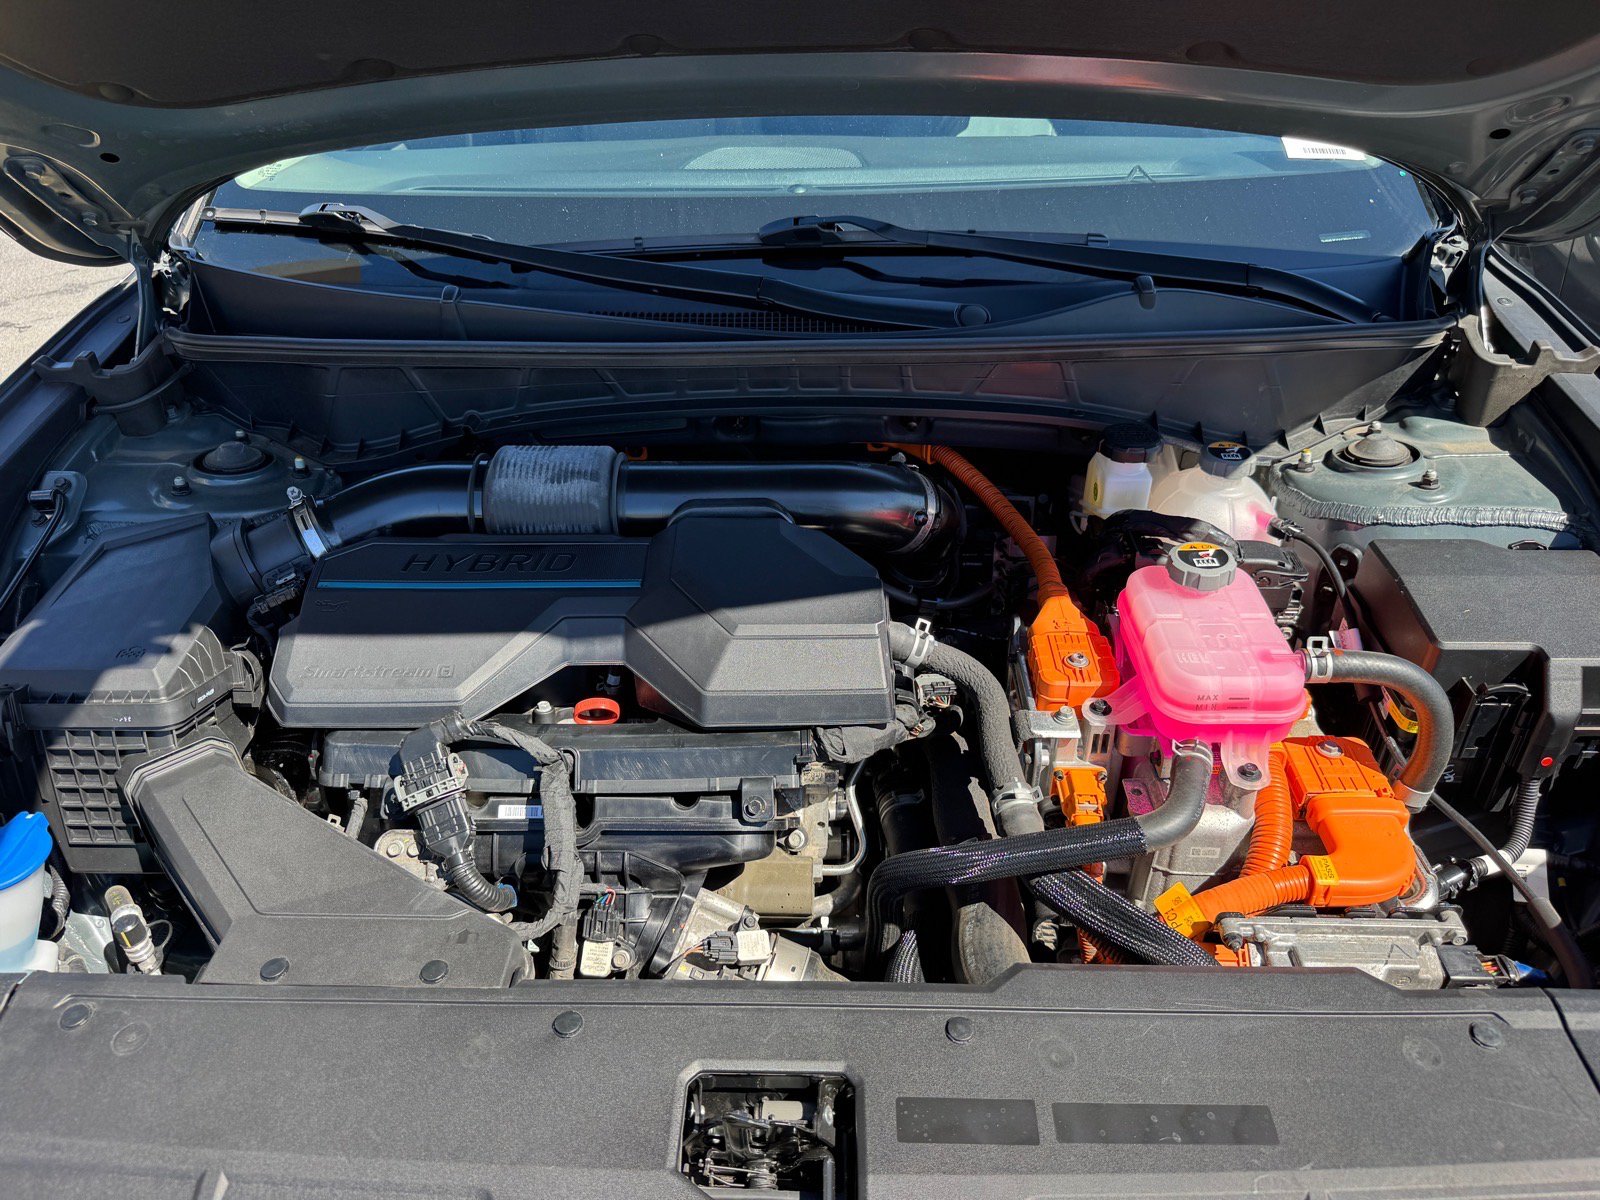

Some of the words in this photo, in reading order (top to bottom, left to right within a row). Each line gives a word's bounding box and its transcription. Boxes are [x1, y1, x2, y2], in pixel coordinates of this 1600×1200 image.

[400, 553, 578, 573] HYBRID
[299, 664, 433, 679] Smartstream
[1196, 694, 1219, 702] MAX
[1195, 703, 1218, 712] MIN
[1164, 907, 1183, 929] PC1
